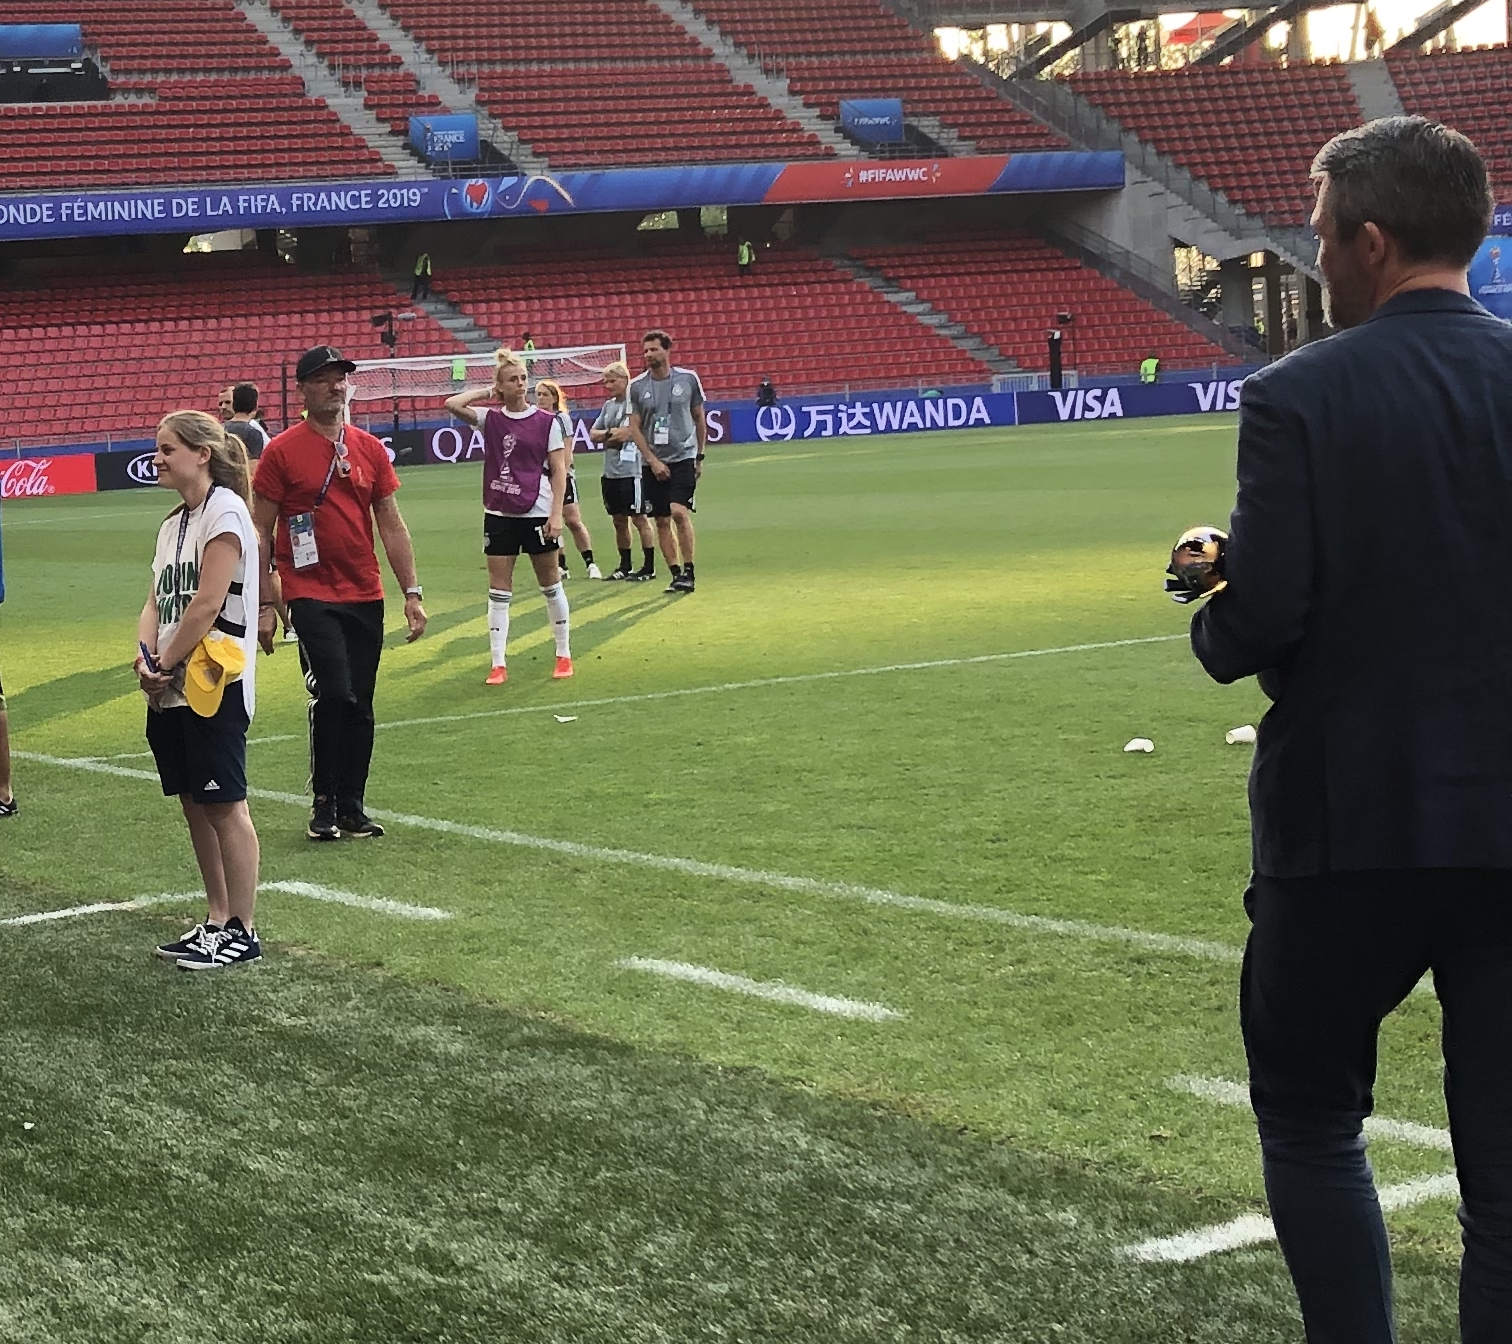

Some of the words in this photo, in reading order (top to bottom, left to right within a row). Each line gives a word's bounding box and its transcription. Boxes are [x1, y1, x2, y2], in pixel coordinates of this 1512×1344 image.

[858, 167, 929, 183] #FIFAWWC
[61, 197, 166, 222] FÉMININE
[172, 197, 200, 219] DE
[206, 195, 233, 217] LA
[237, 193, 287, 216] FIFA,
[291, 189, 373, 212] FRANCE
[377, 187, 421, 208] 2019
[1048, 387, 1124, 421] VISA
[1187, 379, 1244, 412] VIS
[801, 401, 872, 438] 万达
[872, 396, 992, 431] WANDA
